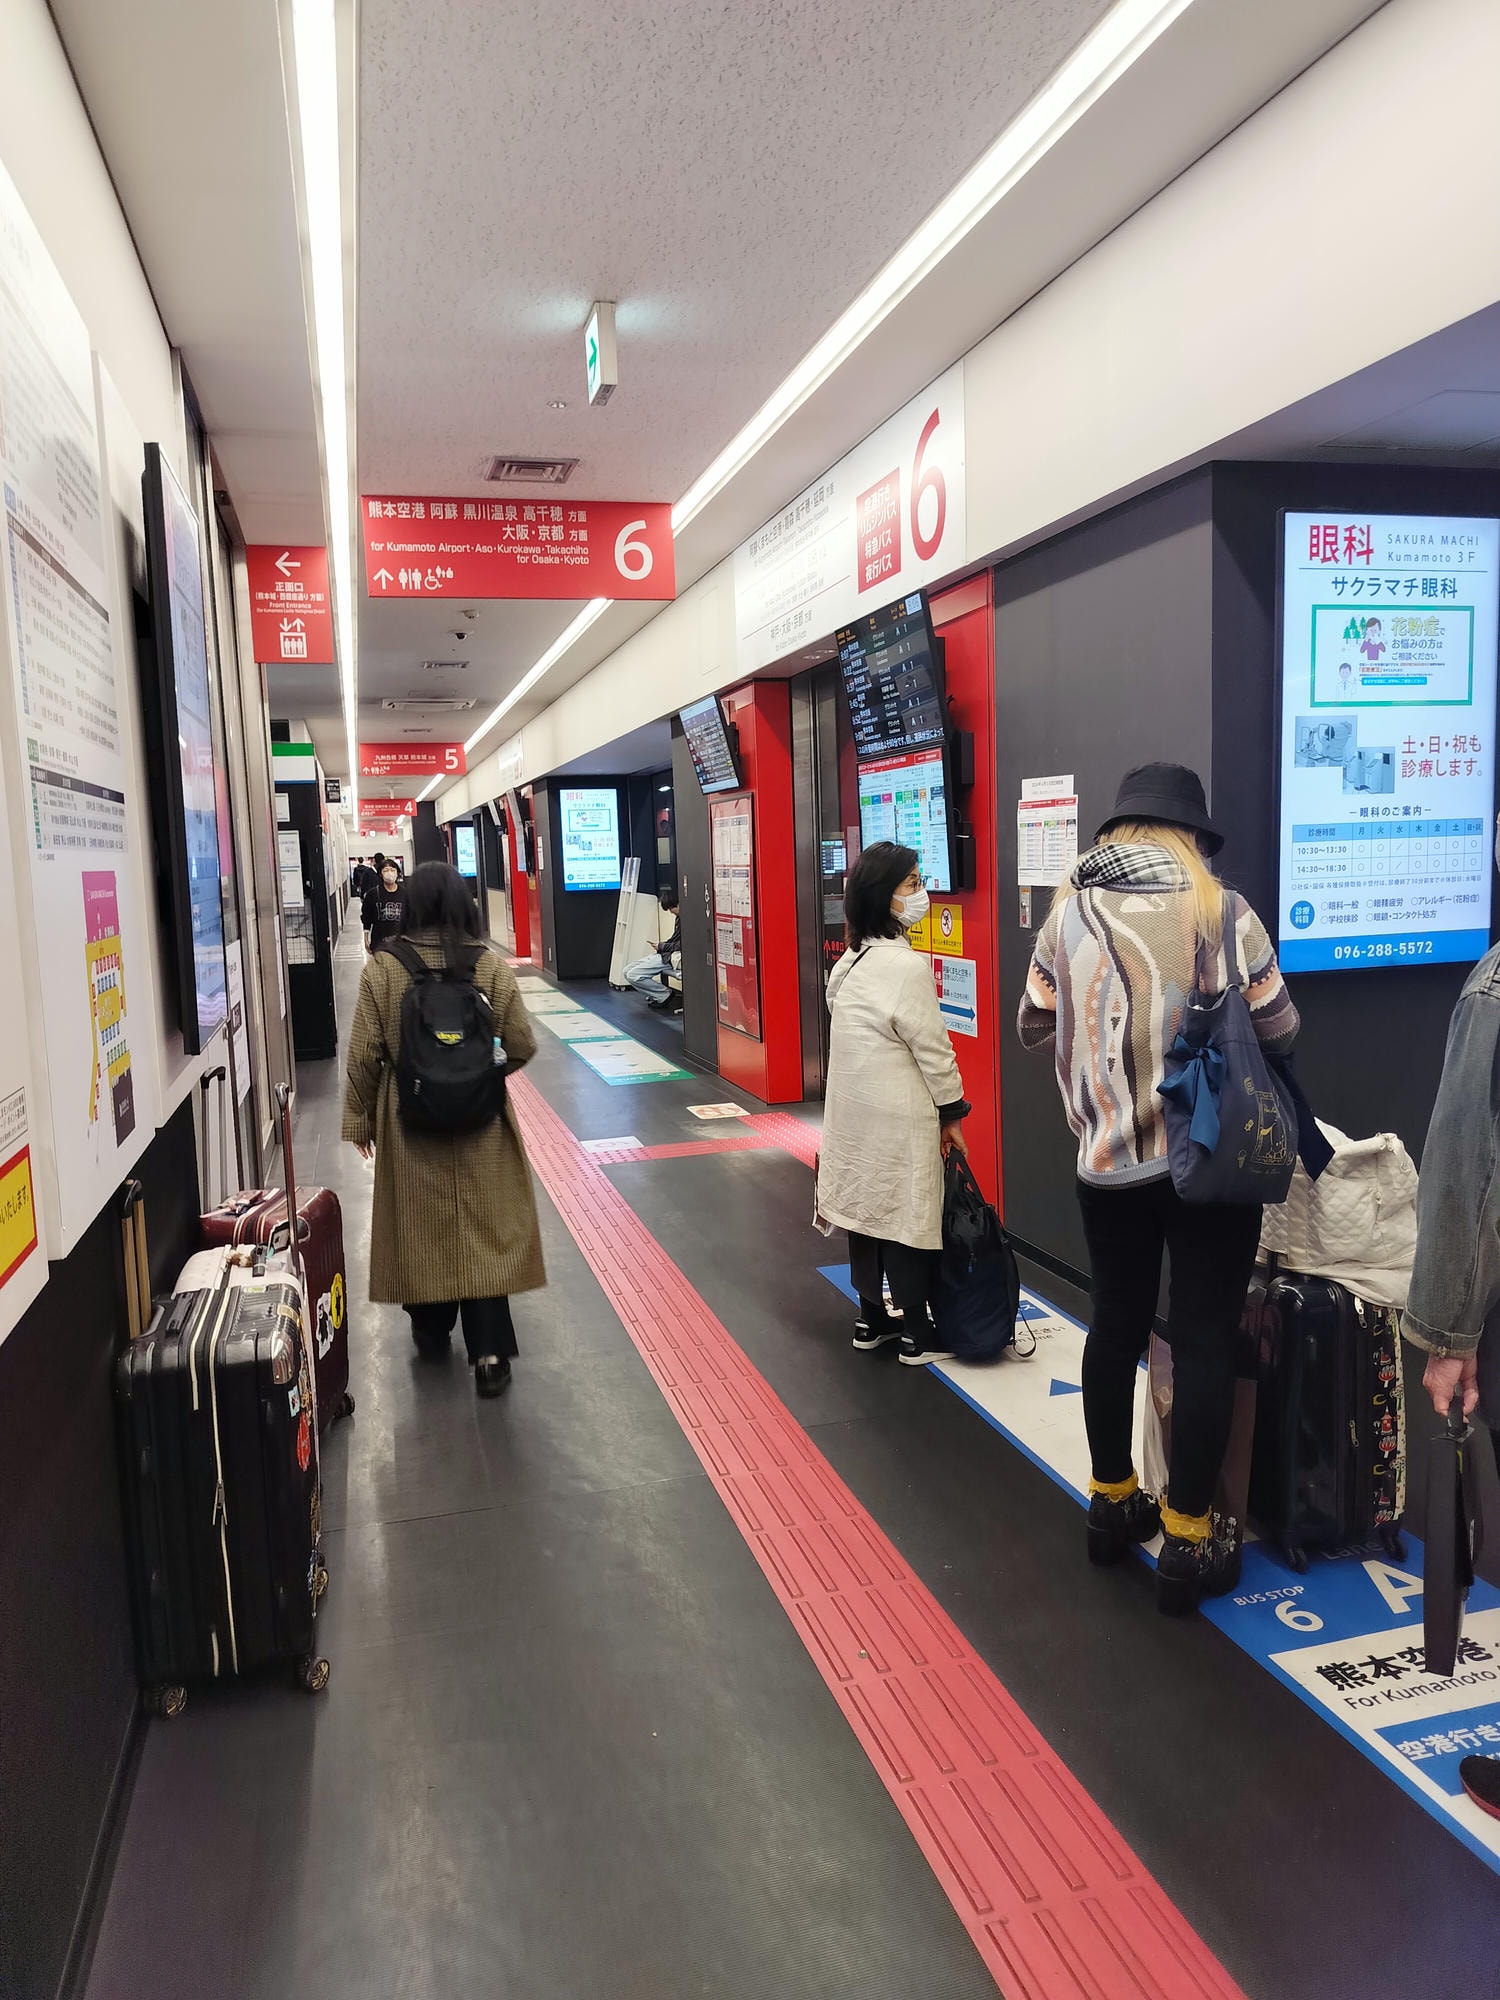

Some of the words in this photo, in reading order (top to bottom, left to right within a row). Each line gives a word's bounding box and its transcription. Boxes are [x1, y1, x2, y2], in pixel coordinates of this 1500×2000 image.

[911, 407, 946, 560] 6
[368, 500, 424, 519] 熊本空港
[430, 502, 458, 519] 阿蘇
[463, 503, 518, 521] 黒川温泉
[523, 505, 563, 522] 高千穂
[568, 510, 587, 523] 方面
[502, 524, 564, 541] 大阪・京都
[569, 529, 588, 541] 方面
[864, 527, 892, 559] 特急バス
[1387, 533, 1434, 546] SAKURA
[1441, 535, 1479, 546] MACHI
[370, 541, 384, 552] for
[387, 542, 436, 553] Kumamoto
[615, 520, 653, 580] 6
[1309, 524, 1374, 565] 眼科
[517, 554, 530, 565] for
[865, 553, 892, 583] 夜行バス
[1388, 552, 1451, 563] Kumamoto
[275, 581, 304, 592] 正面口
[1332, 576, 1458, 598] サクラマチ眼科
[1391, 616, 1445, 637] 花粉症で
[1391, 638, 1443, 649] お悩みの方は
[1391, 652, 1438, 661] ご相談ください
[1402, 735, 1482, 754] 土・日・祝も
[445, 748, 458, 769] 5
[1401, 758, 1482, 778] 診療します。
[404, 801, 413, 813] 4
[1308, 828, 1336, 838] 診療時間
[1415, 825, 1422, 833] 木
[1434, 824, 1441, 832] 金
[1452, 823, 1459, 832] 土
[1334, 941, 1433, 959] 096-288-5572
[1233, 1593, 1265, 1607] BUS
[1266, 1586, 1305, 1600] STOP
[1361, 1559, 1424, 1614] A
[1275, 1600, 1324, 1632] 6
[1343, 1693, 1382, 1709] For
[1380, 1670, 1497, 1702] Kumamoto
[1396, 1721, 1500, 1760] 空港行き
